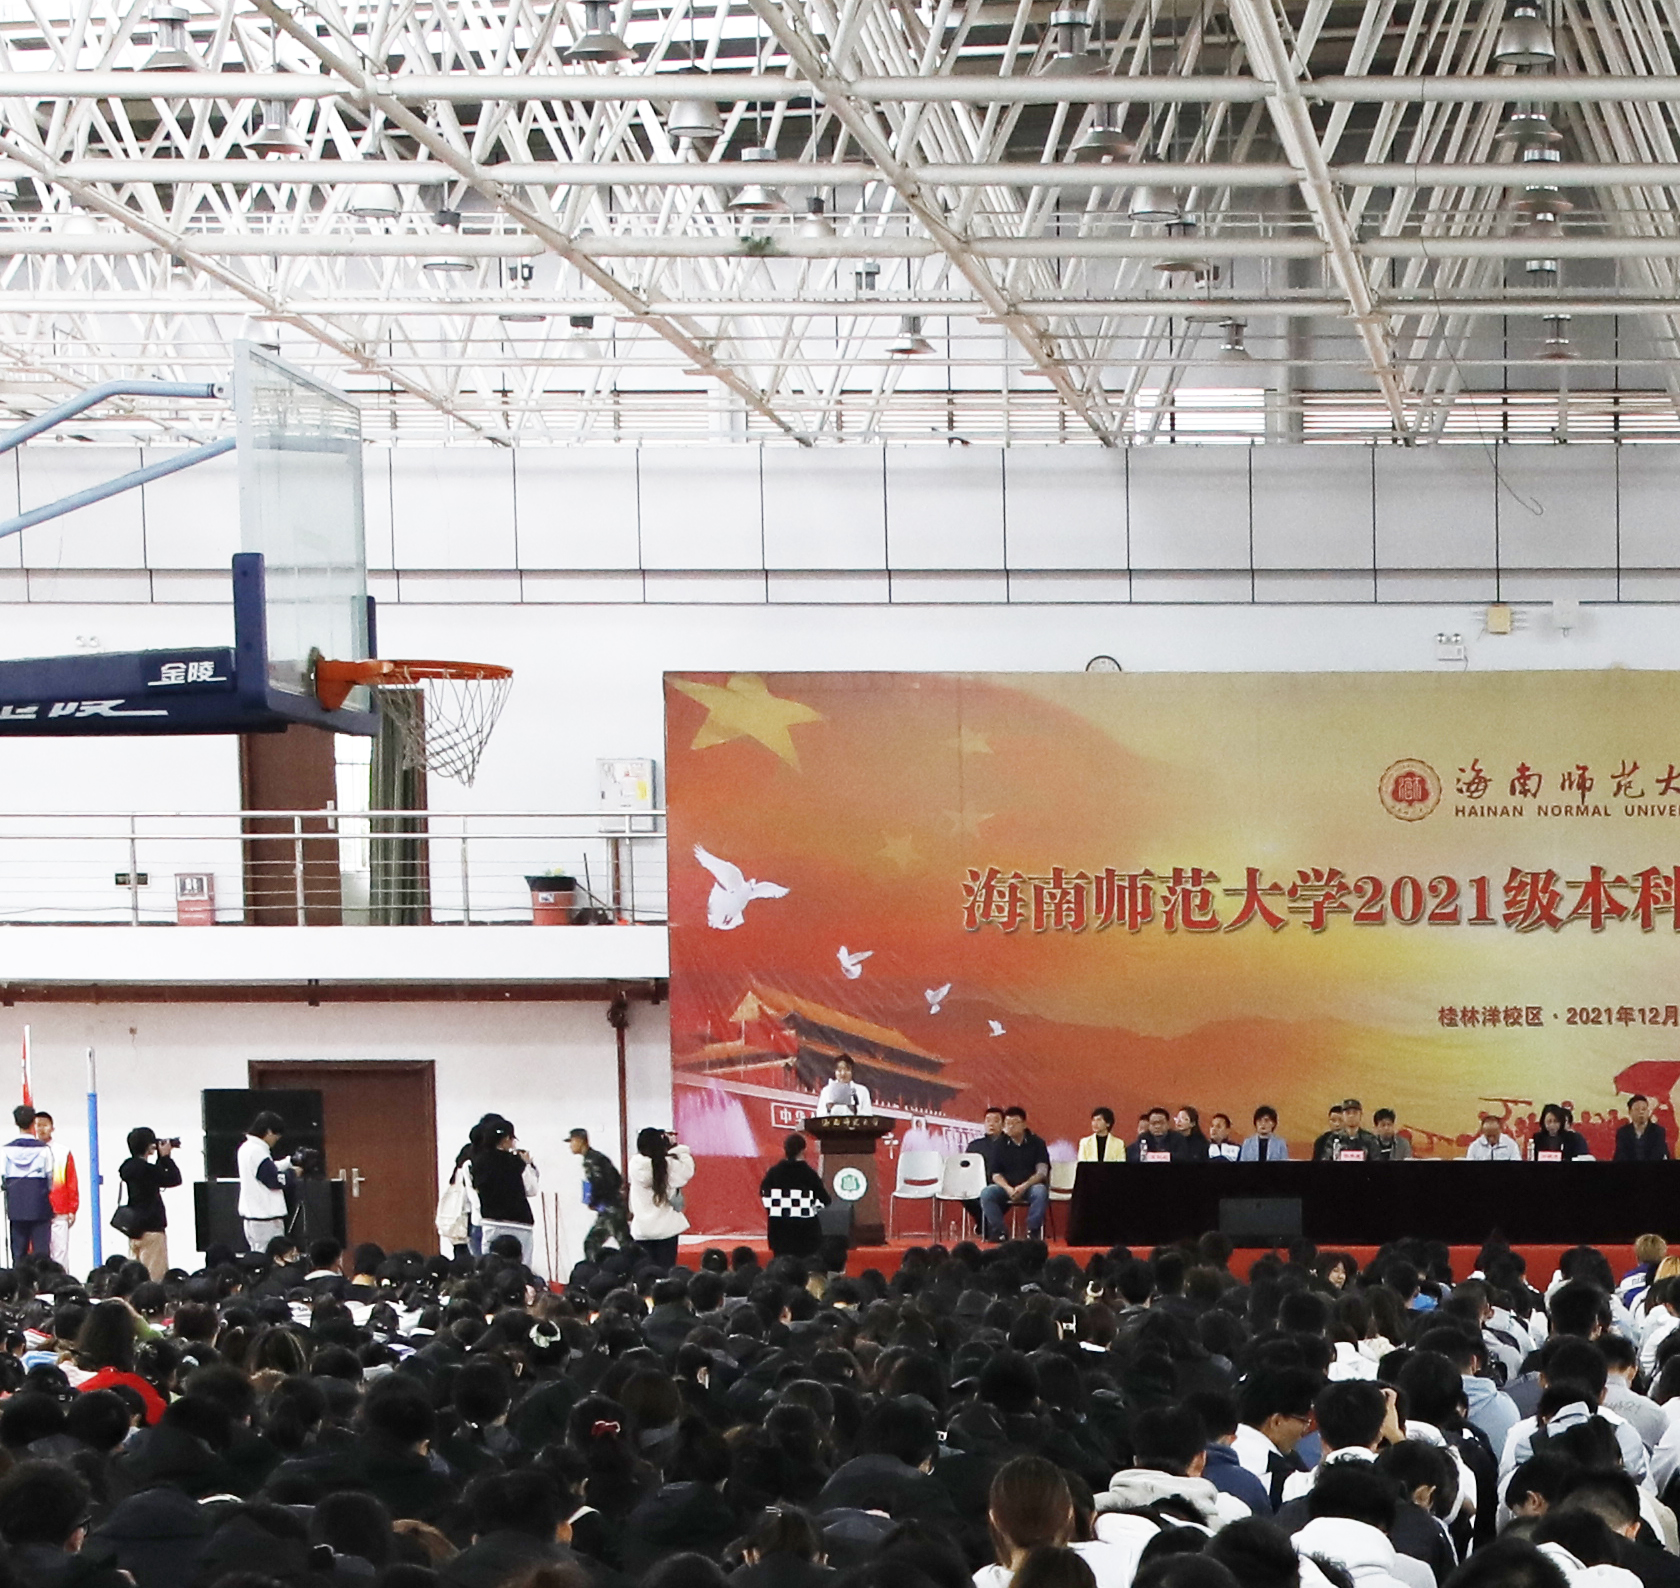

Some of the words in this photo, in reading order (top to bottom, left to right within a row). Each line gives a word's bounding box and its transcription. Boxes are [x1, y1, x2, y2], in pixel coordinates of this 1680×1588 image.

[160, 661, 215, 684] 金陵
[1455, 804, 1524, 818] HAINAN
[1537, 804, 1612, 818] NORMAL
